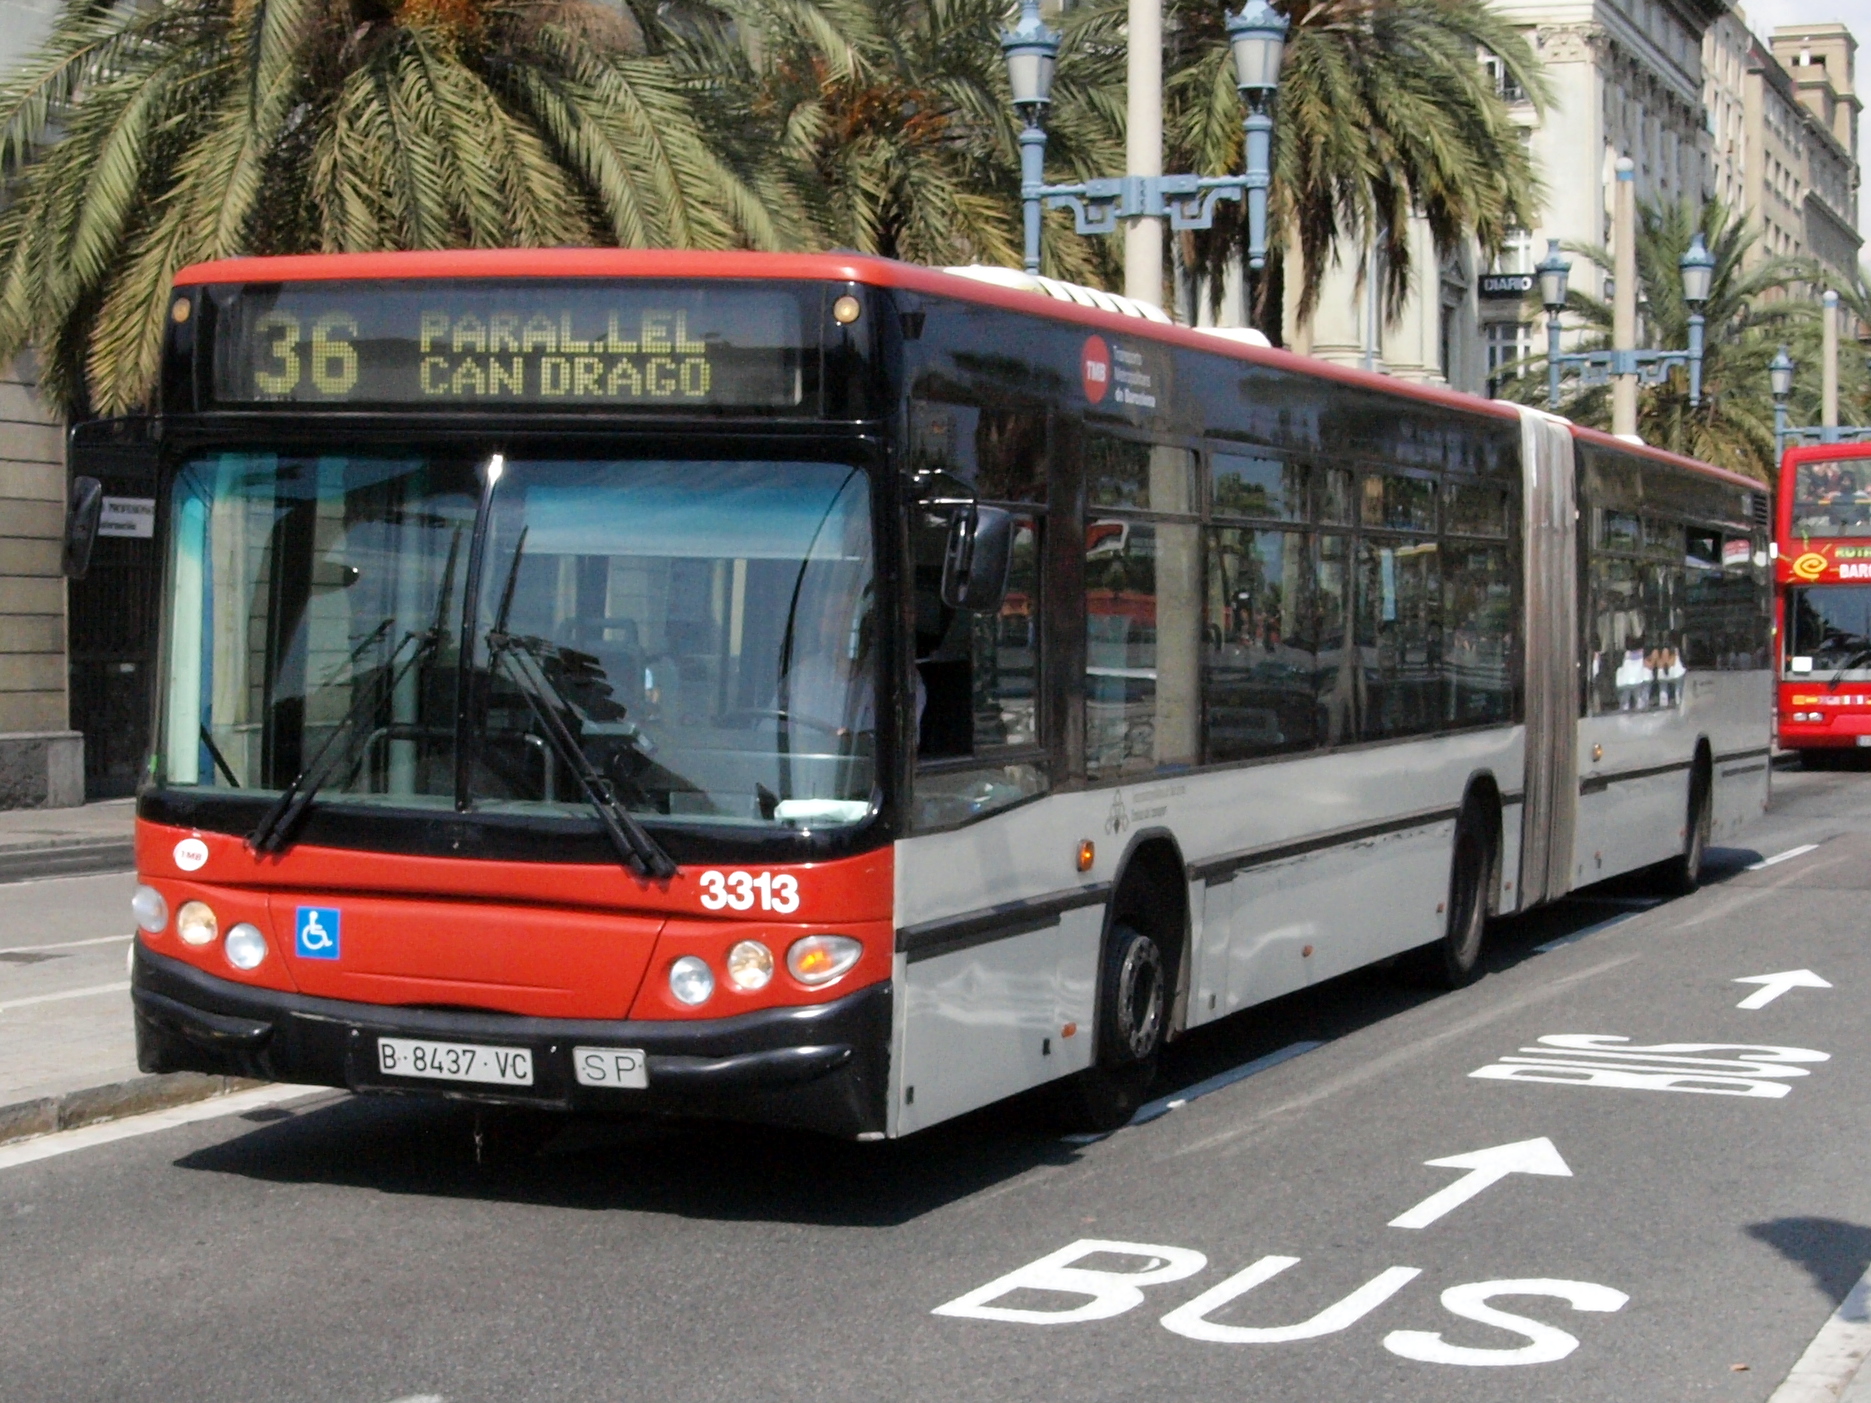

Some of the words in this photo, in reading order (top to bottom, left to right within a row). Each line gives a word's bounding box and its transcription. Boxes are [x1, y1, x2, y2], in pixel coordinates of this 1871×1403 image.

[254, 308, 359, 395] 36
[1086, 360, 1106, 383] TMB
[420, 356, 524, 396] CAN
[540, 356, 711, 397] DRAGO
[1839, 563, 1871, 579] BAR
[699, 870, 800, 914] 3313
[1467, 1033, 1832, 1099] BUS
[931, 1238, 1630, 1367] BUS
